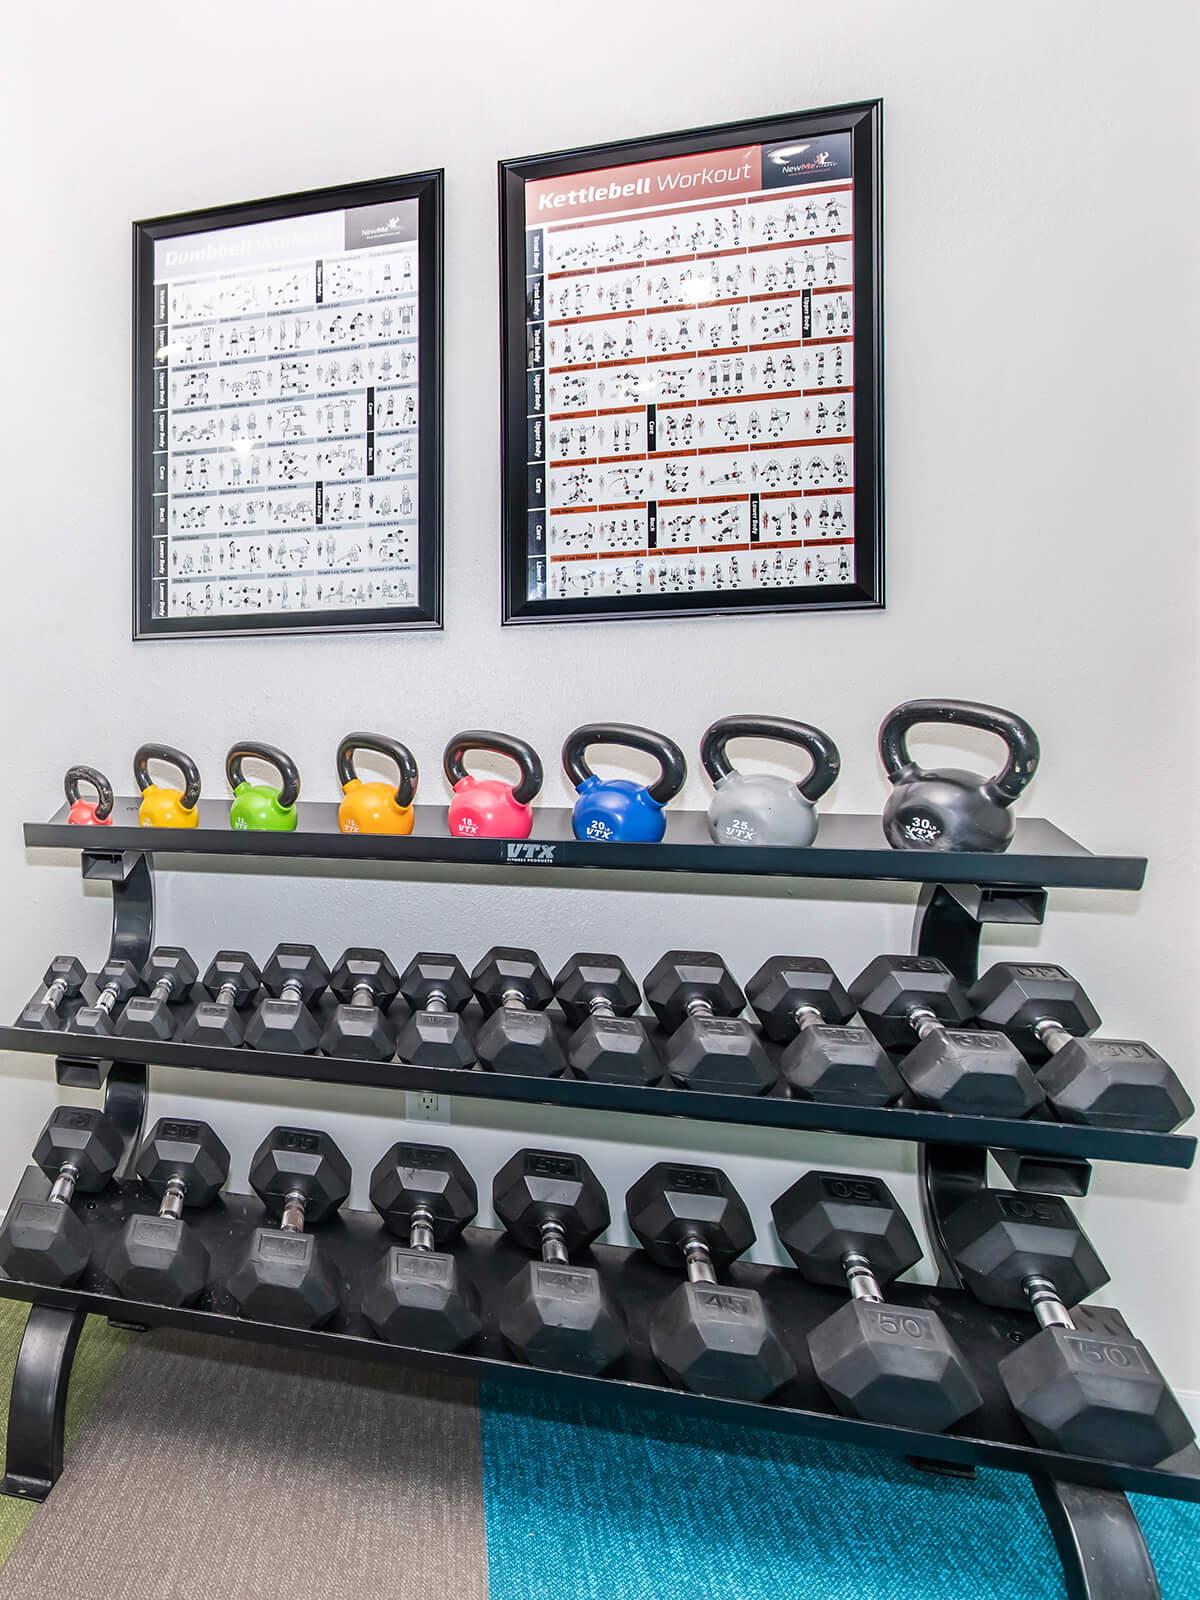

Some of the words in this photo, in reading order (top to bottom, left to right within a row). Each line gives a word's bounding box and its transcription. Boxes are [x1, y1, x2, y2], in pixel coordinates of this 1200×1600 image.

[782, 162, 815, 174] NewMe
[538, 177, 651, 210] Kettlebell
[658, 162, 752, 191] Workout
[165, 239, 256, 267] Dumbbell
[534, 374, 542, 392] Upper
[458, 823, 479, 834] VTX
[586, 827, 614, 839] VTX
[726, 827, 757, 840] VTX
[905, 825, 941, 840] VTX
[507, 843, 557, 859] VTX
[705, 1294, 748, 1315] 45
[878, 1313, 922, 1339] 50
[1078, 1342, 1128, 1368] 50
